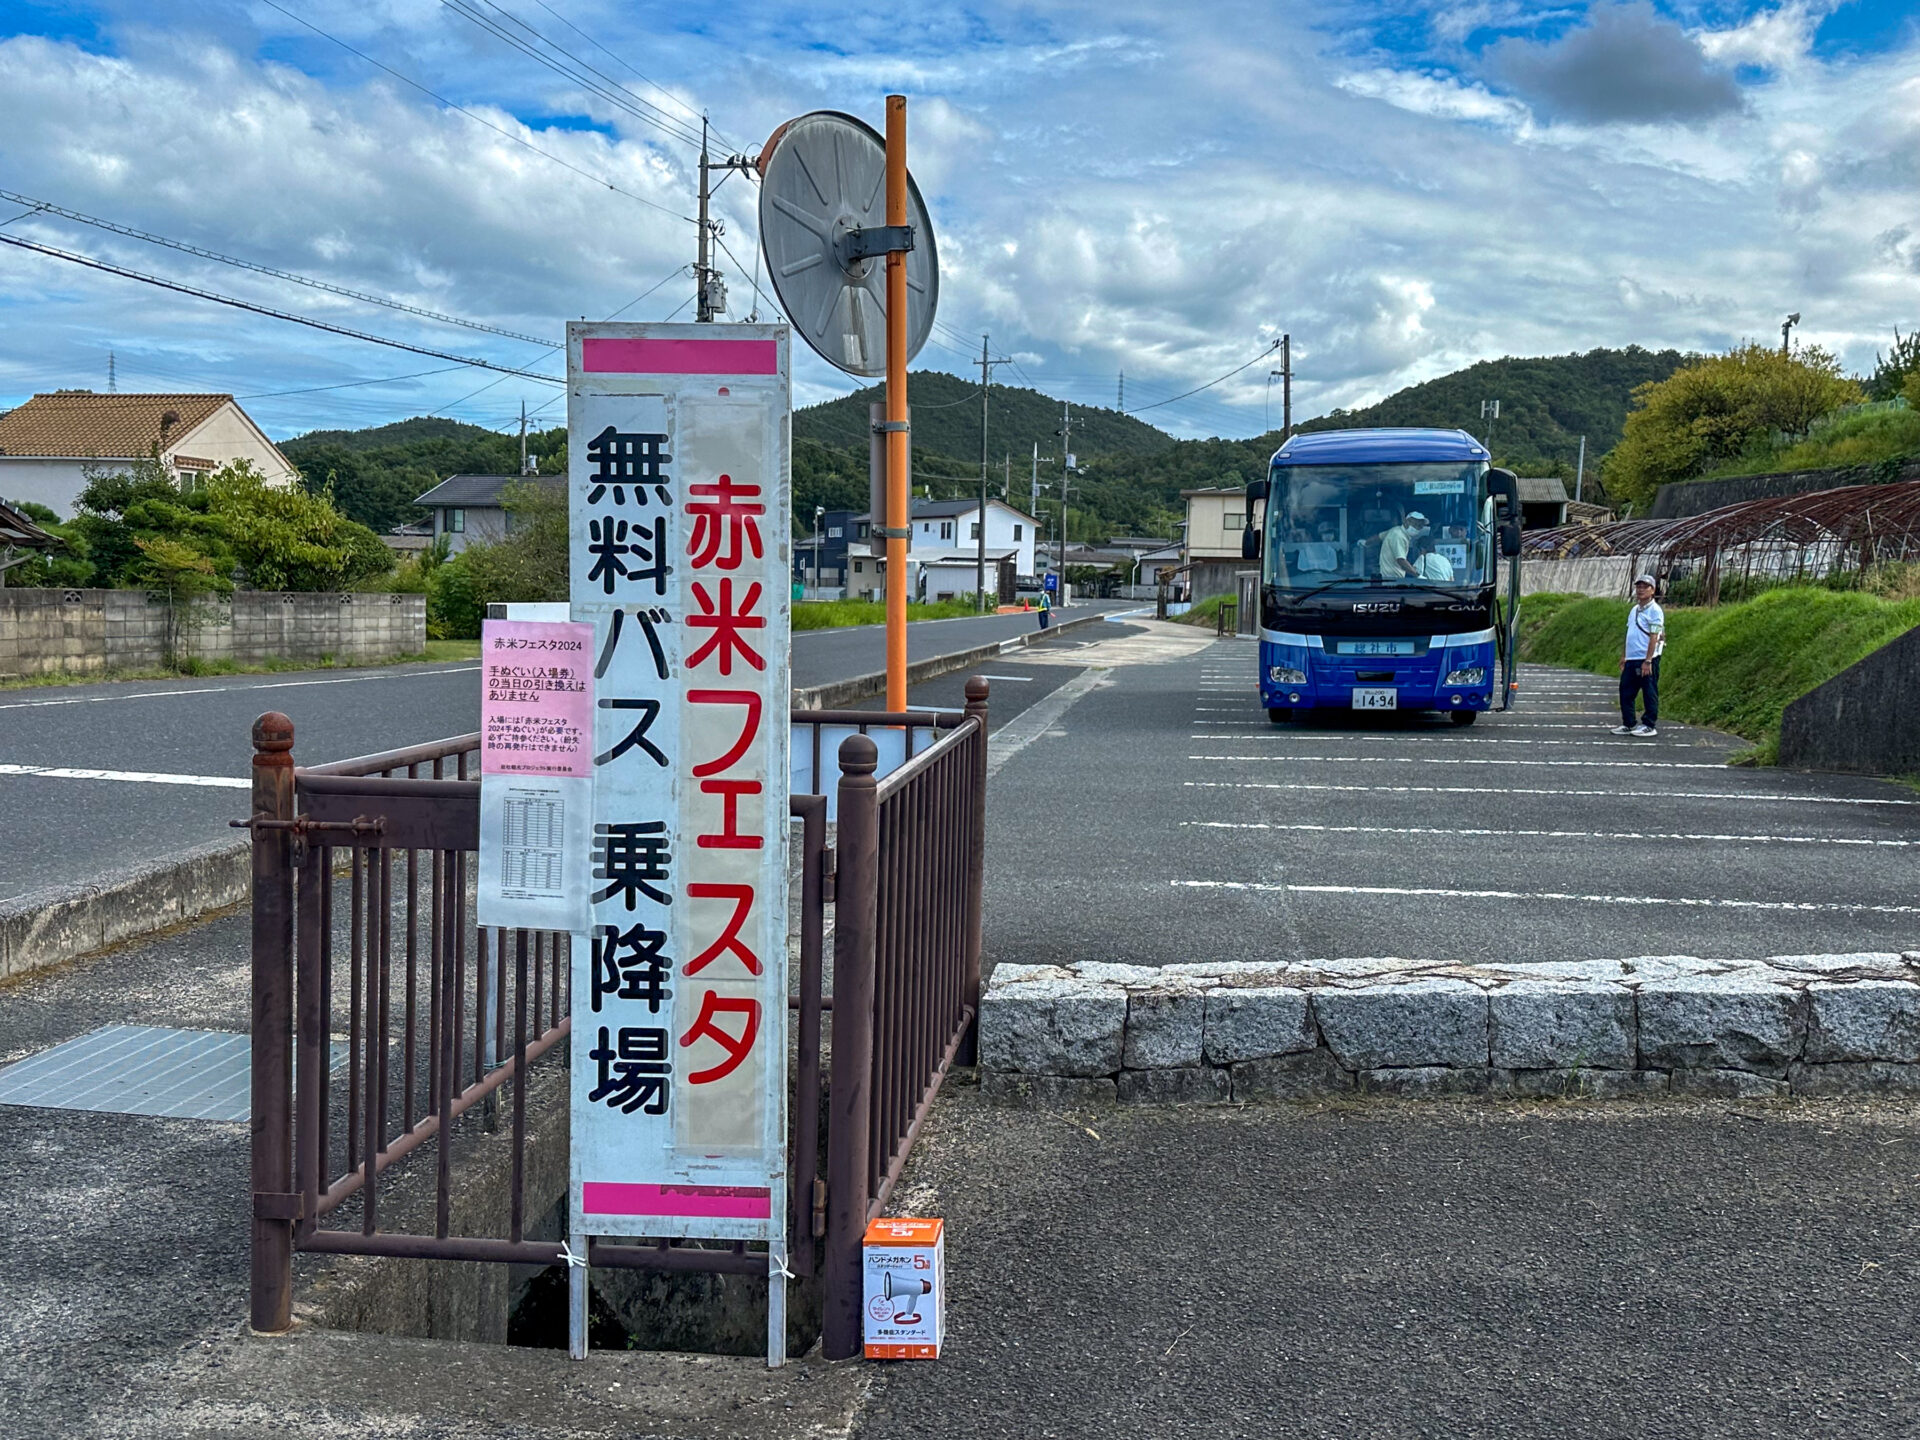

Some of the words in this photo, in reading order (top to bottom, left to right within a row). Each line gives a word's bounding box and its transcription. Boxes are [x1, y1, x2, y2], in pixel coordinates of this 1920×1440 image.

[586, 426, 673, 767] 無料バス
[1352, 603, 1400, 613] ISUZU
[494, 637, 582, 651] 赤米フェスタ2024
[489, 678, 586, 691] の当日の引き換えは
[488, 690, 540, 701] ありません
[679, 474, 768, 1085] 赤米フェスタ
[588, 820, 673, 1115] 乗降場
